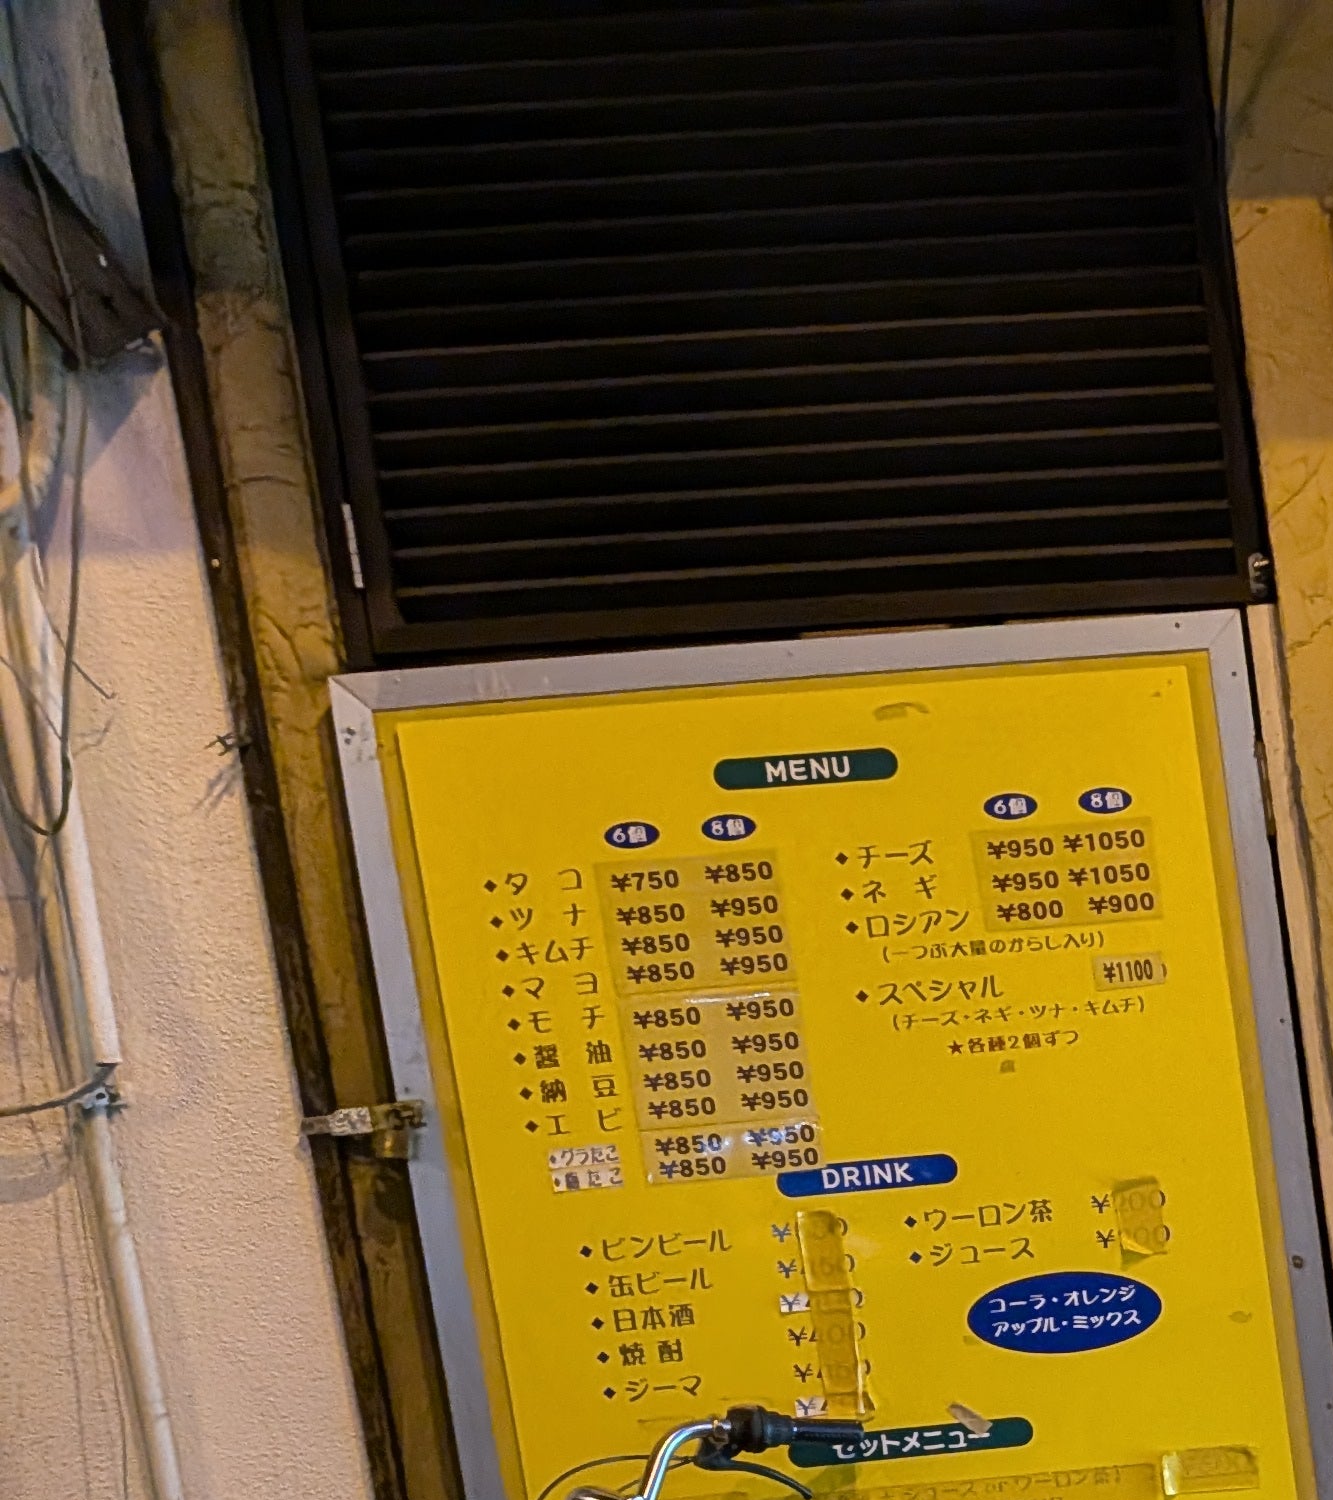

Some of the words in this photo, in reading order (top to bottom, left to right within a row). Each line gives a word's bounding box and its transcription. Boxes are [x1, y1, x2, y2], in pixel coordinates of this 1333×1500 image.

[765, 755, 851, 783] MENU
[857, 839, 935, 869] チーズ
[987, 836, 1055, 860] ¥950
[1063, 828, 1146, 854] ¥1050
[611, 868, 680, 892] ¥750
[705, 860, 774, 884] ¥850
[992, 870, 1060, 893] ¥950
[1068, 862, 1151, 887] ¥1050
[616, 903, 686, 926] ¥850
[711, 895, 779, 919] ¥950
[865, 908, 970, 939] ロシアン
[996, 899, 1064, 922] ¥800
[1088, 892, 1155, 914] ¥900
[516, 935, 595, 965] キムチ
[622, 933, 691, 956] ¥850
[715, 925, 784, 949] ¥950
[627, 961, 696, 984] ¥850
[720, 953, 789, 977] ¥950
[879, 974, 1005, 1006] スペシャル
[1102, 958, 1155, 983] ¥1100
[633, 1006, 702, 1030] ¥850
[726, 998, 795, 1022] ¥950
[638, 1039, 708, 1063] ¥850
[732, 1031, 800, 1054] ¥950
[643, 1069, 712, 1092] ¥850
[737, 1060, 805, 1083] ¥950
[648, 1096, 717, 1120] ¥850
[741, 1088, 810, 1112] ¥950
[655, 1132, 723, 1156] ¥850
[748, 1124, 816, 1147] ¥950
[660, 1155, 727, 1179] ¥850
[751, 1147, 820, 1170] ¥950
[821, 1162, 915, 1190] DRINK
[923, 1198, 1054, 1233] ウーロン茶
[601, 1228, 733, 1263] ビンビール
[929, 1236, 1036, 1268] ジュース
[607, 1266, 714, 1299] 缶ビール
[613, 1304, 696, 1333] 日本酒
[618, 1339, 685, 1367] 焼酎
[624, 1373, 703, 1403] ジーマ
